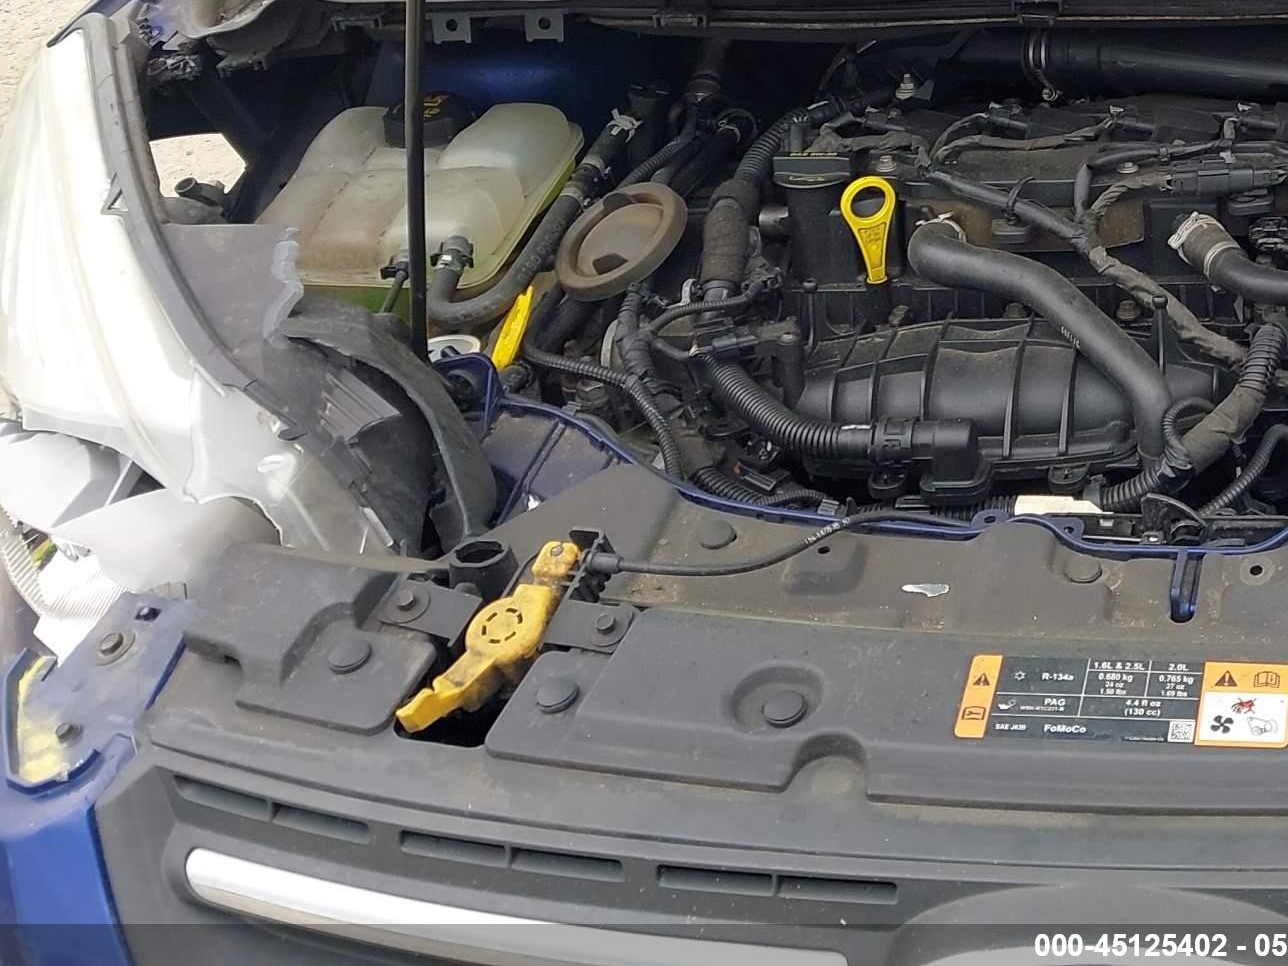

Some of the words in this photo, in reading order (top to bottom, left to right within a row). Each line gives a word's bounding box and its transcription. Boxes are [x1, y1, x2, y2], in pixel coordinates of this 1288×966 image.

[1094, 661, 1113, 669] 1.6L
[1125, 662, 1145, 670] 2.5L
[1168, 663, 1189, 671] 2.0L
[1041, 672, 1074, 681] R-134a
[1098, 672, 1121, 681] 0.680
[1122, 673, 1134, 683] kg
[1158, 674, 1182, 683] 0.765
[1182, 675, 1194, 685] kg
[1044, 698, 1066, 706] PAG
[1125, 699, 1140, 707] 4.4
[1140, 699, 1148, 707] fl
[1124, 708, 1145, 717] (130
[1145, 708, 1161, 717] cc)
[994, 723, 1009, 731] SAE
[1043, 723, 1087, 734] FoMoCo
